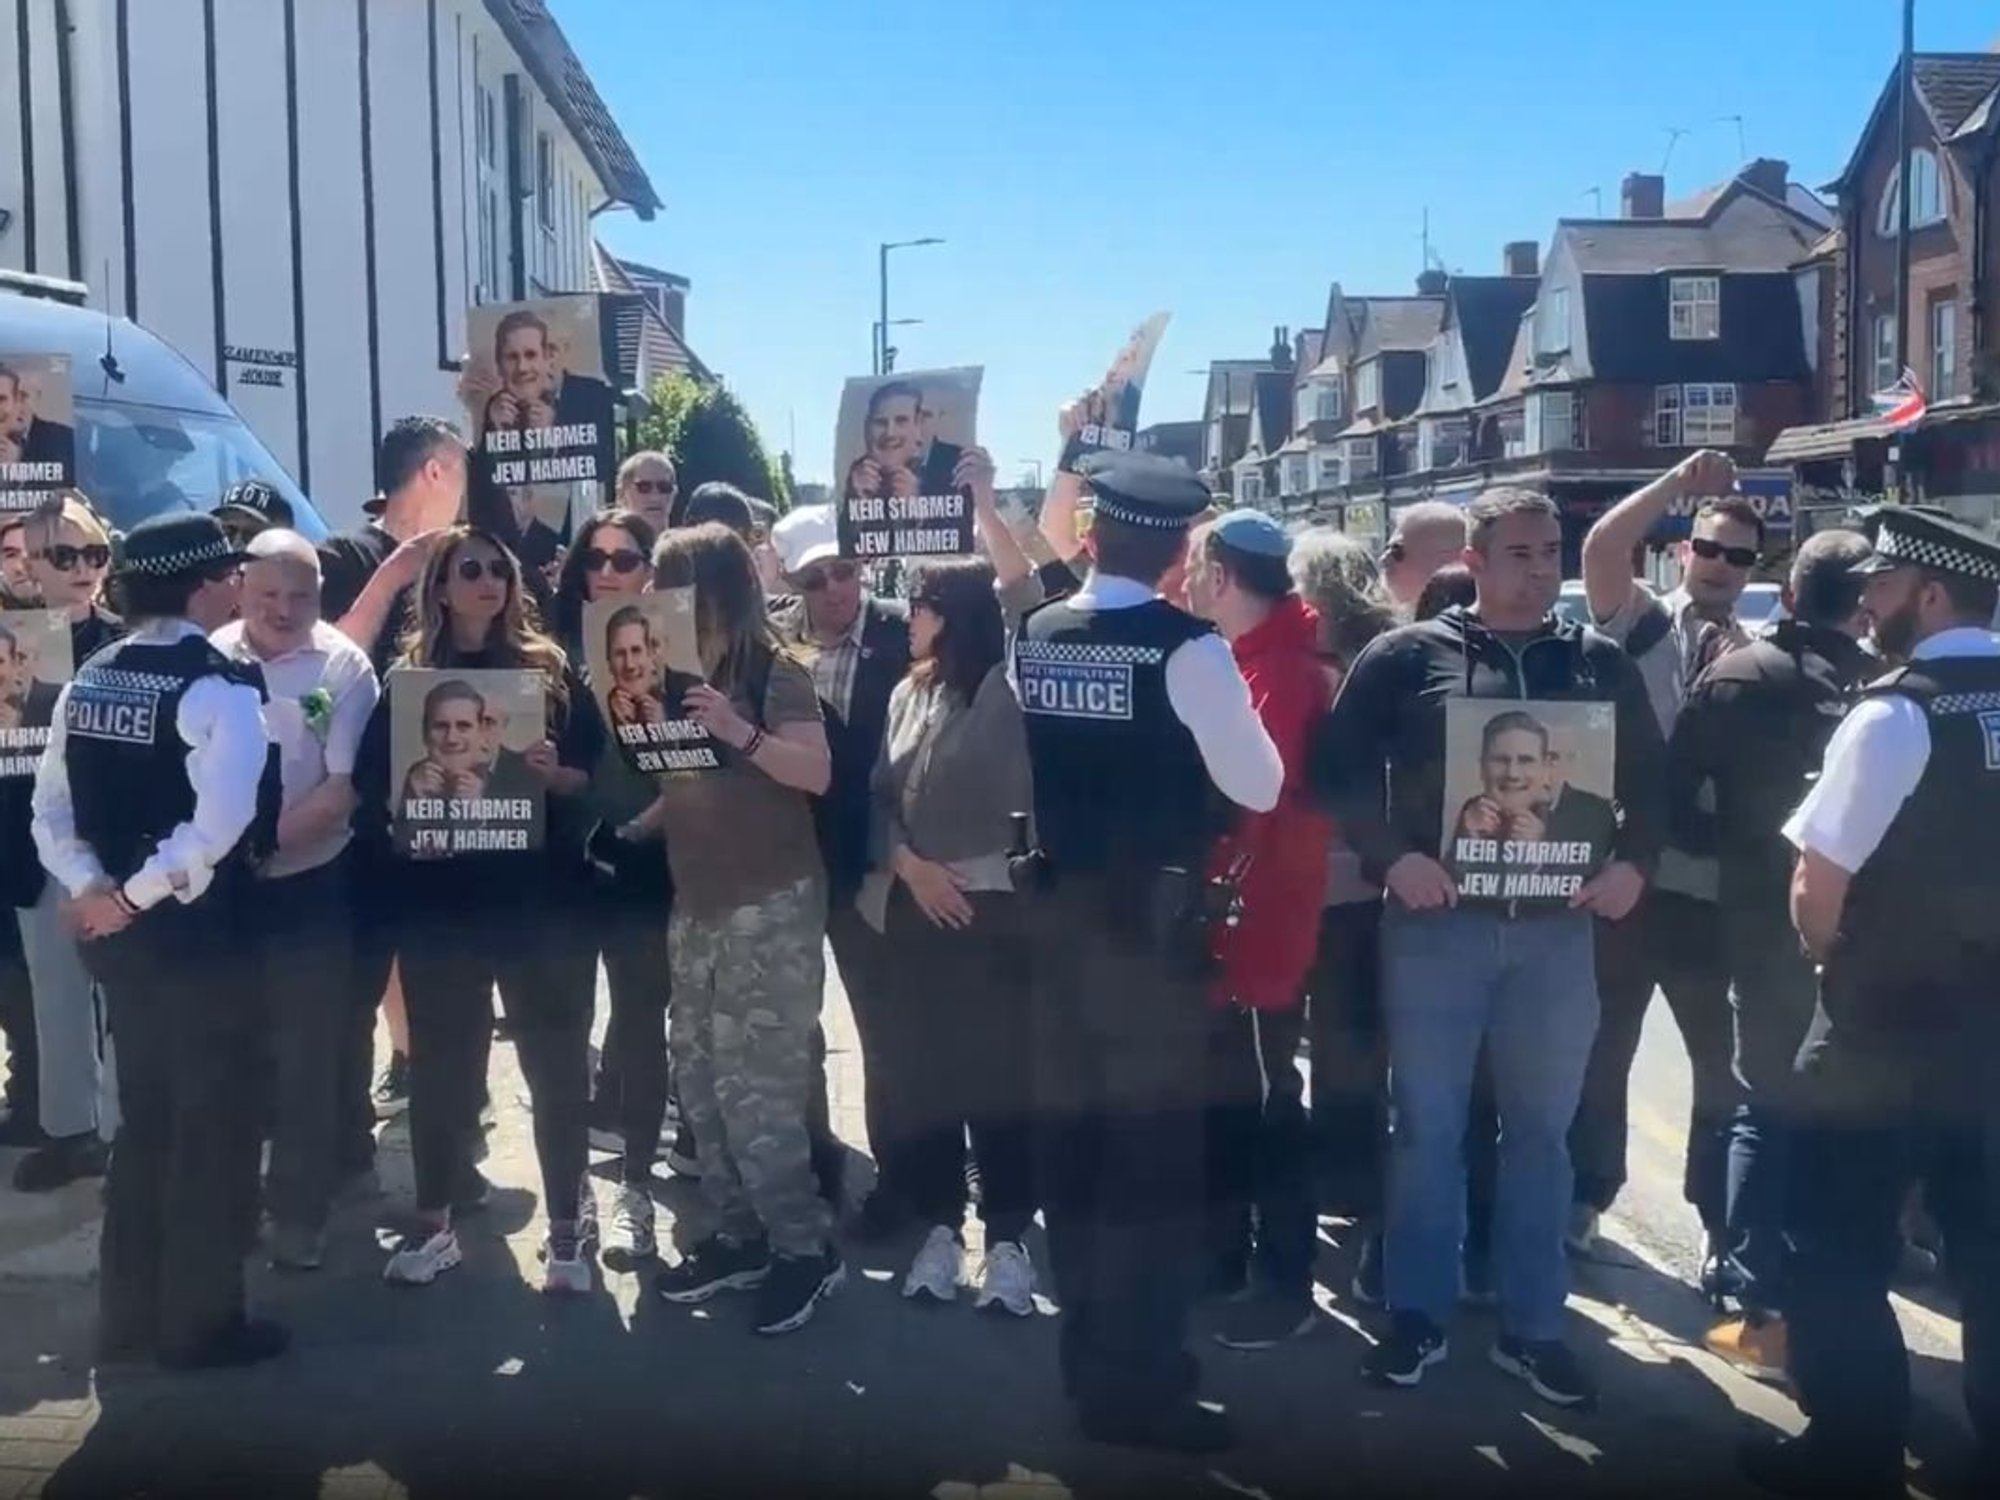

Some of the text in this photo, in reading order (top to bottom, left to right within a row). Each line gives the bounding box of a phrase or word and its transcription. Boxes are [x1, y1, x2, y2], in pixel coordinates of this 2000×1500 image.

[485, 423, 597, 453] KEIR STARMER
[0, 462, 63, 481] TARMER
[491, 456, 597, 484] JEW HARMER
[848, 495, 964, 521] KEIR STARMER
[854, 529, 960, 554] JEW HARMER
[1025, 678, 1126, 714] POLICE
[67, 700, 151, 738] POLICE
[406, 798, 532, 821] KEIR STARMER
[410, 829, 528, 851] JEW HARMER
[1456, 838, 1592, 864] KEIR STARMER
[1458, 873, 1583, 897] JEW HARMER
